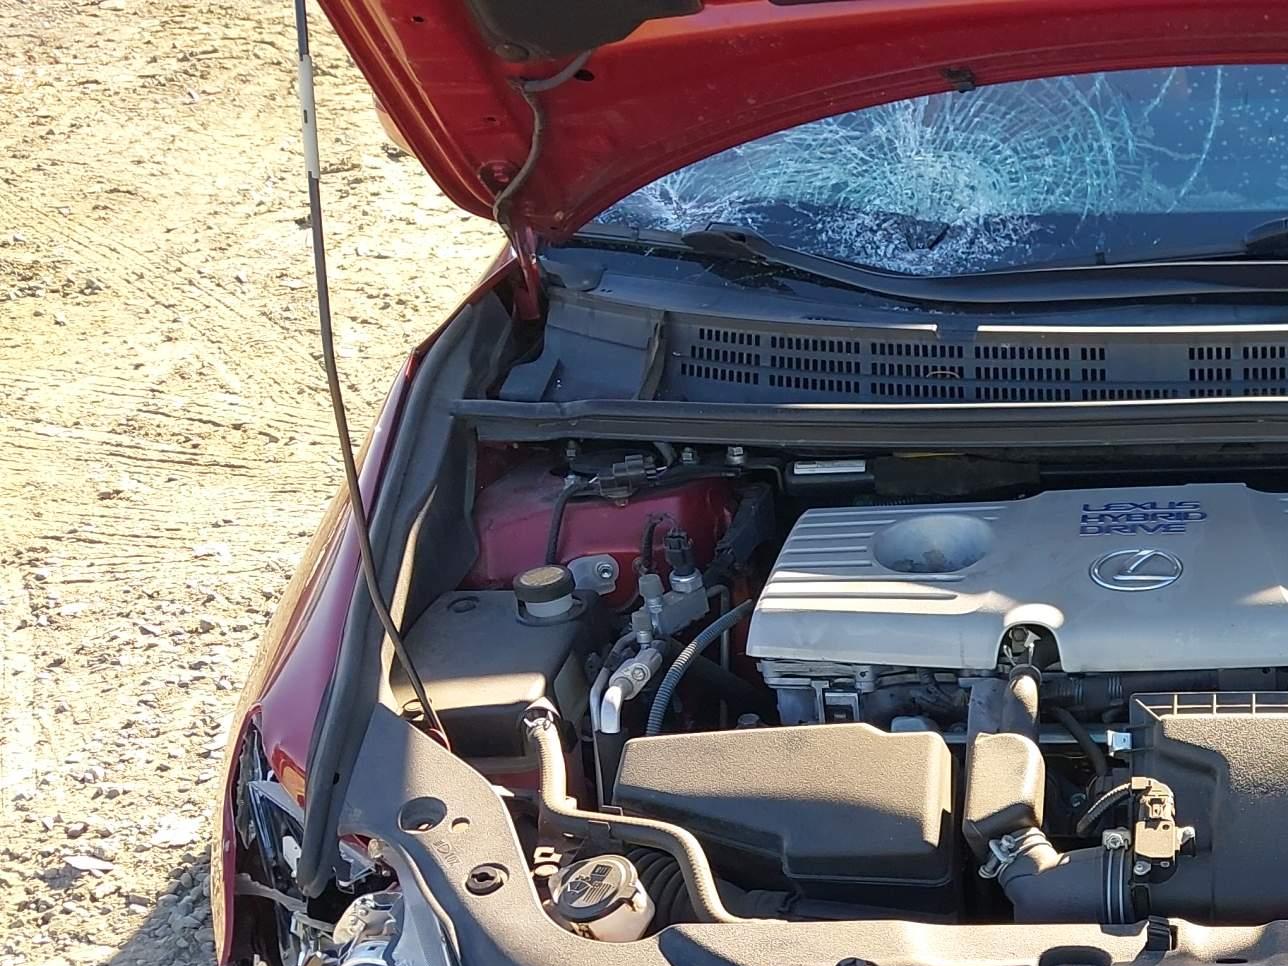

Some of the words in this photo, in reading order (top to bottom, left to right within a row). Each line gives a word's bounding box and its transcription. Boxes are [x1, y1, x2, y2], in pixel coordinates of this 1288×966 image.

[1082, 500, 1200, 512] LEXUS
[1080, 512, 1208, 524] HYBRID
[1079, 524, 1187, 536] DRIVE
